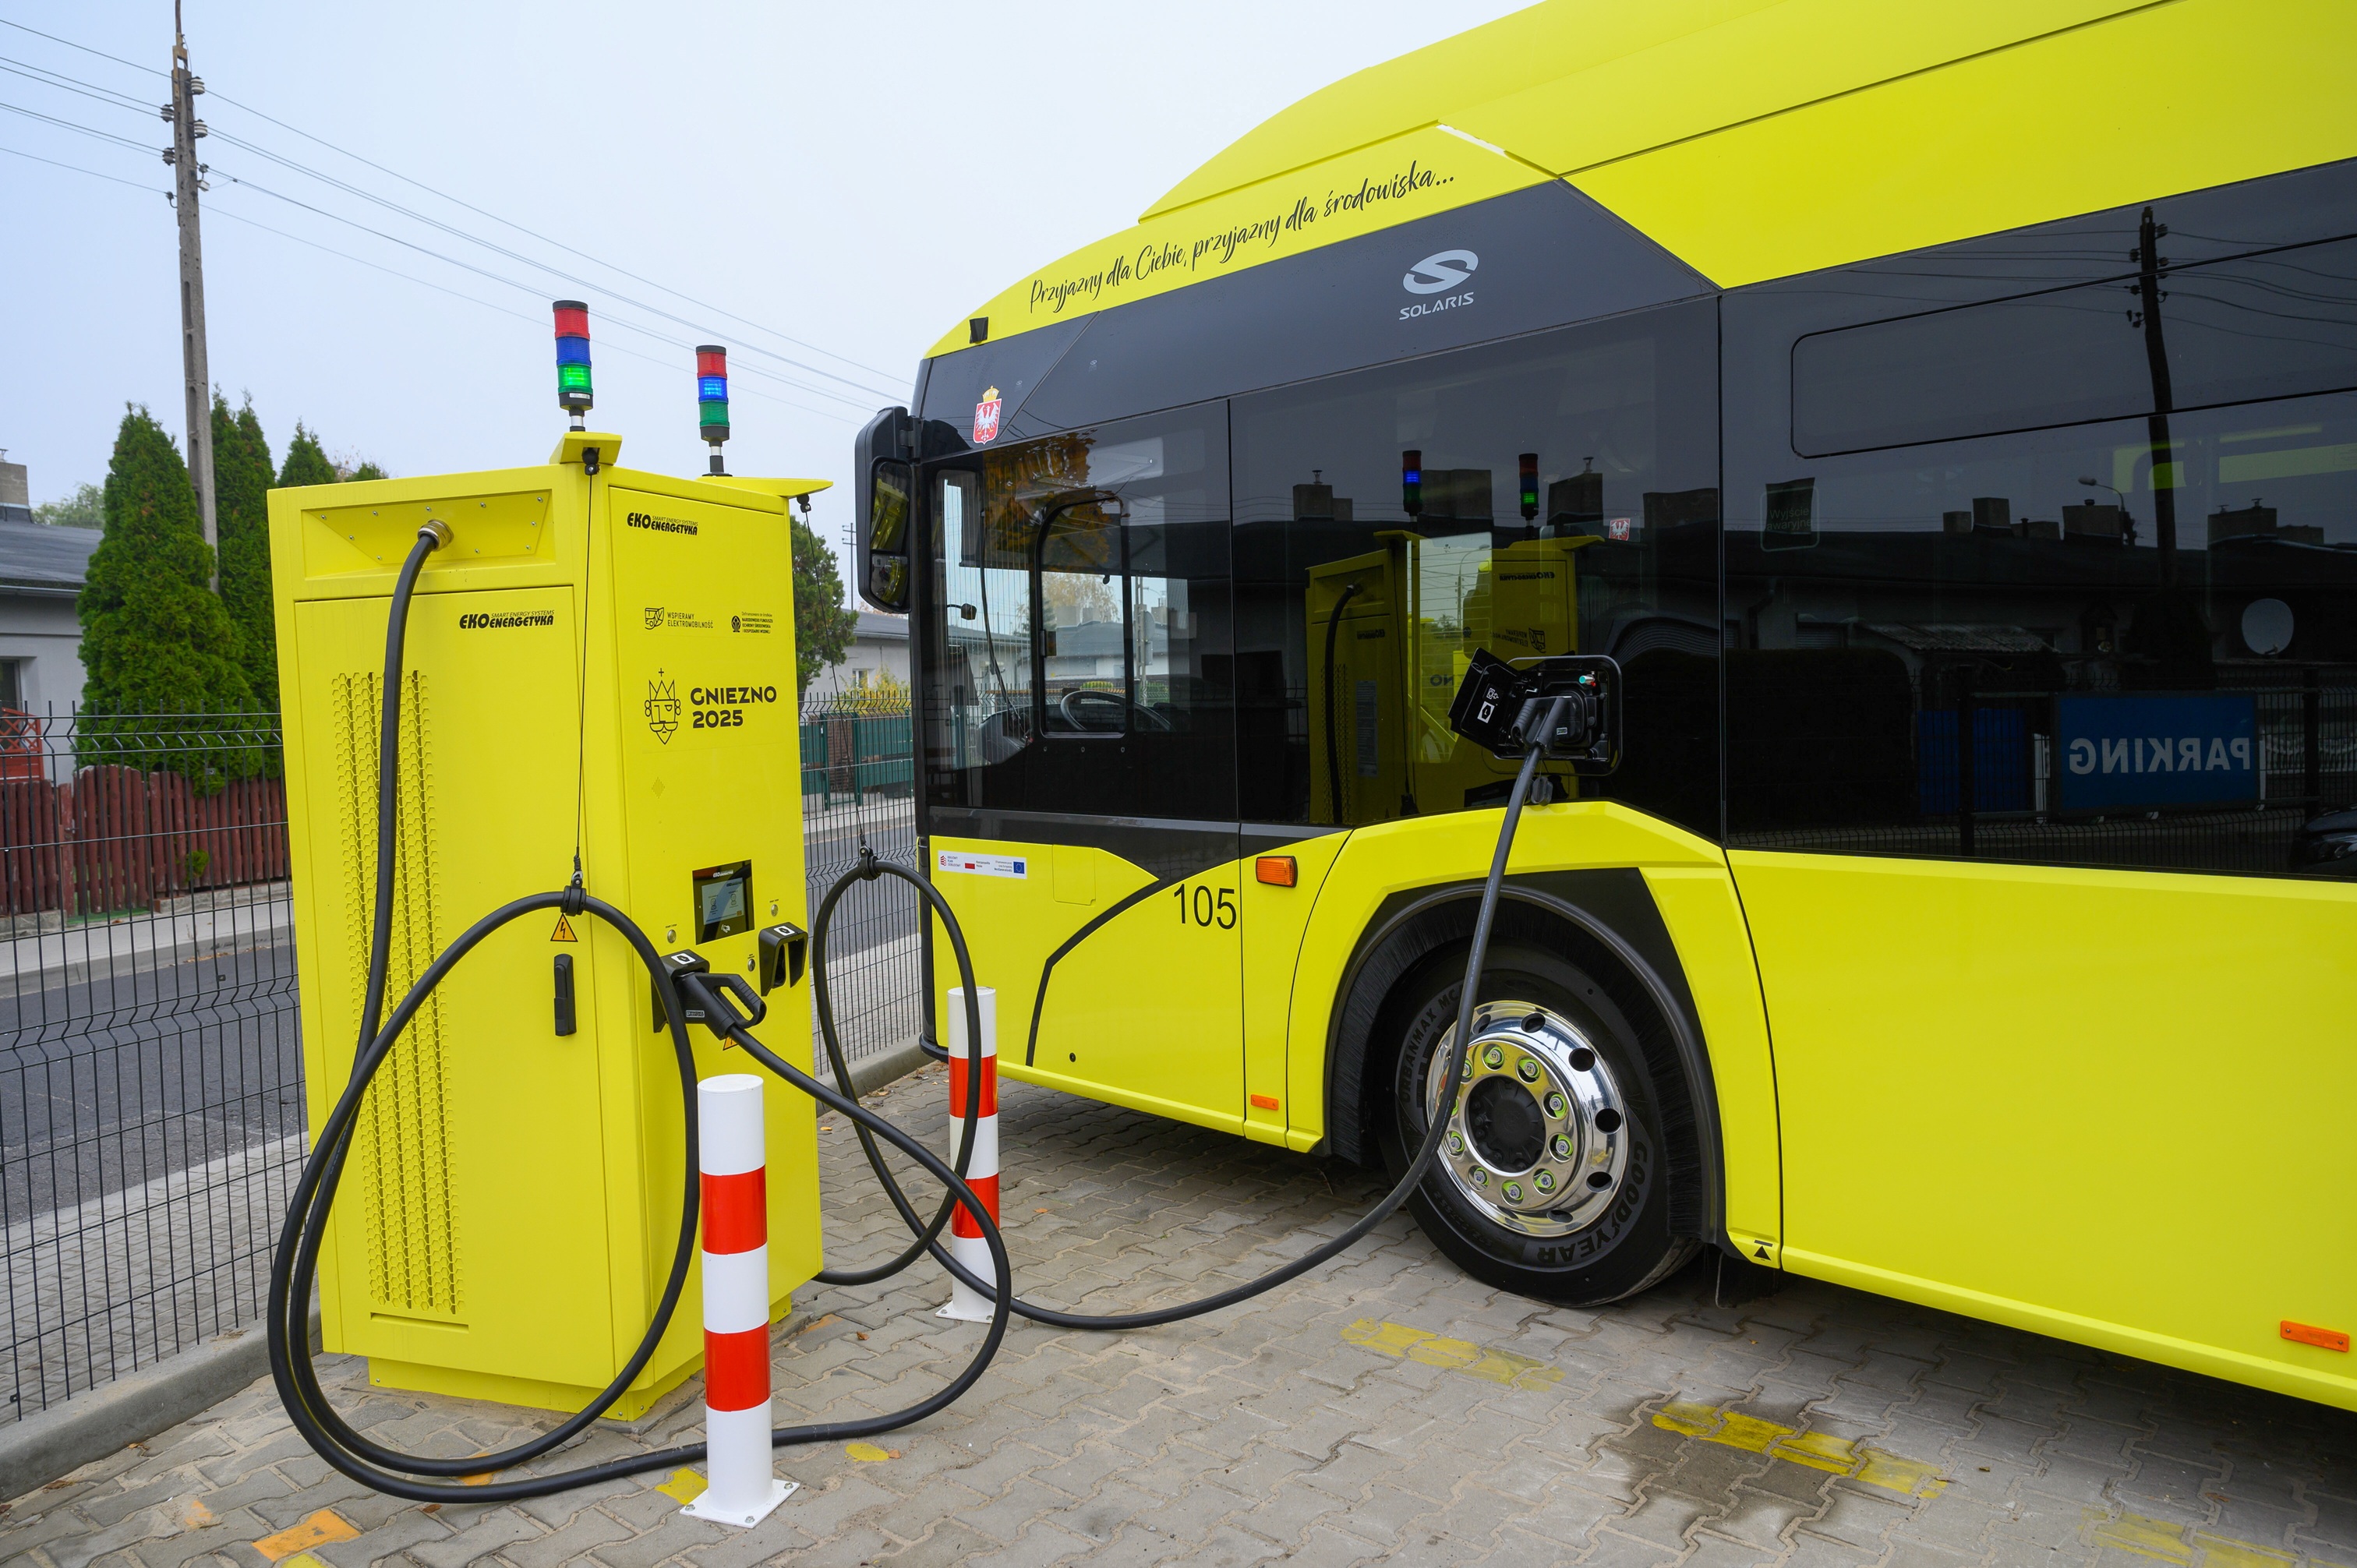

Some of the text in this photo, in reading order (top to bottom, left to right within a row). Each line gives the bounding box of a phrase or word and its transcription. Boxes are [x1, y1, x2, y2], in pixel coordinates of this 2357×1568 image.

[1030, 271, 1103, 314] Przyjazny
[1106, 256, 1133, 288] dla
[1136, 242, 1187, 281] Ciebie,
[1193, 215, 1281, 272] przyjazny
[1285, 196, 1319, 231] dla
[1398, 291, 1475, 320] SOLARIS
[1769, 506, 1809, 521] Wyjście
[667, 612, 694, 620] WSPIERAMY
[690, 685, 777, 706] GNIEZNO
[692, 709, 744, 729] 2025
[1173, 883, 1237, 930] 105
[1401, 1008, 1438, 1104] URBANMAX
[1536, 1140, 1648, 1264] GOODYEAR
